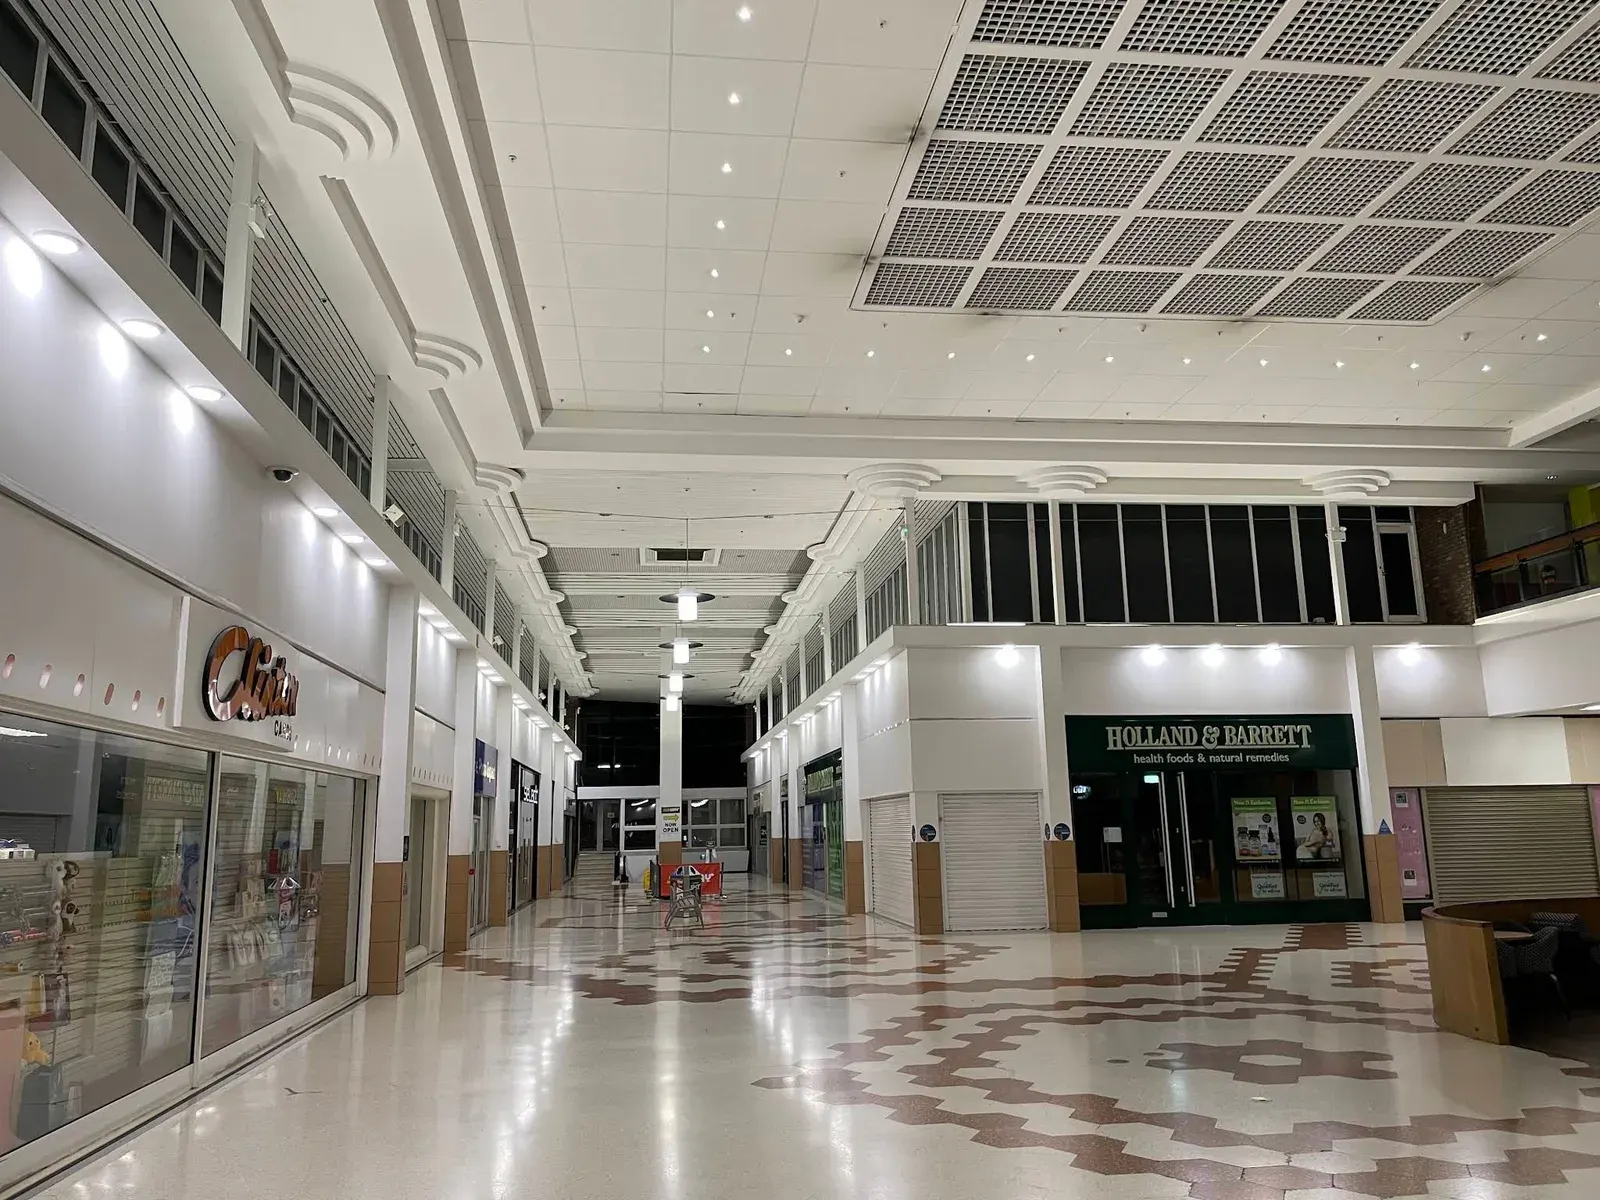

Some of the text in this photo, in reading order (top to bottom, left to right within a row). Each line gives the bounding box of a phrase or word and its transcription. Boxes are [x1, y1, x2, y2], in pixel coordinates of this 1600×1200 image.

[1105, 725, 1312, 750] HOLLAND & BARRETT
[1133, 752, 1290, 764] health foods & natural remedies
